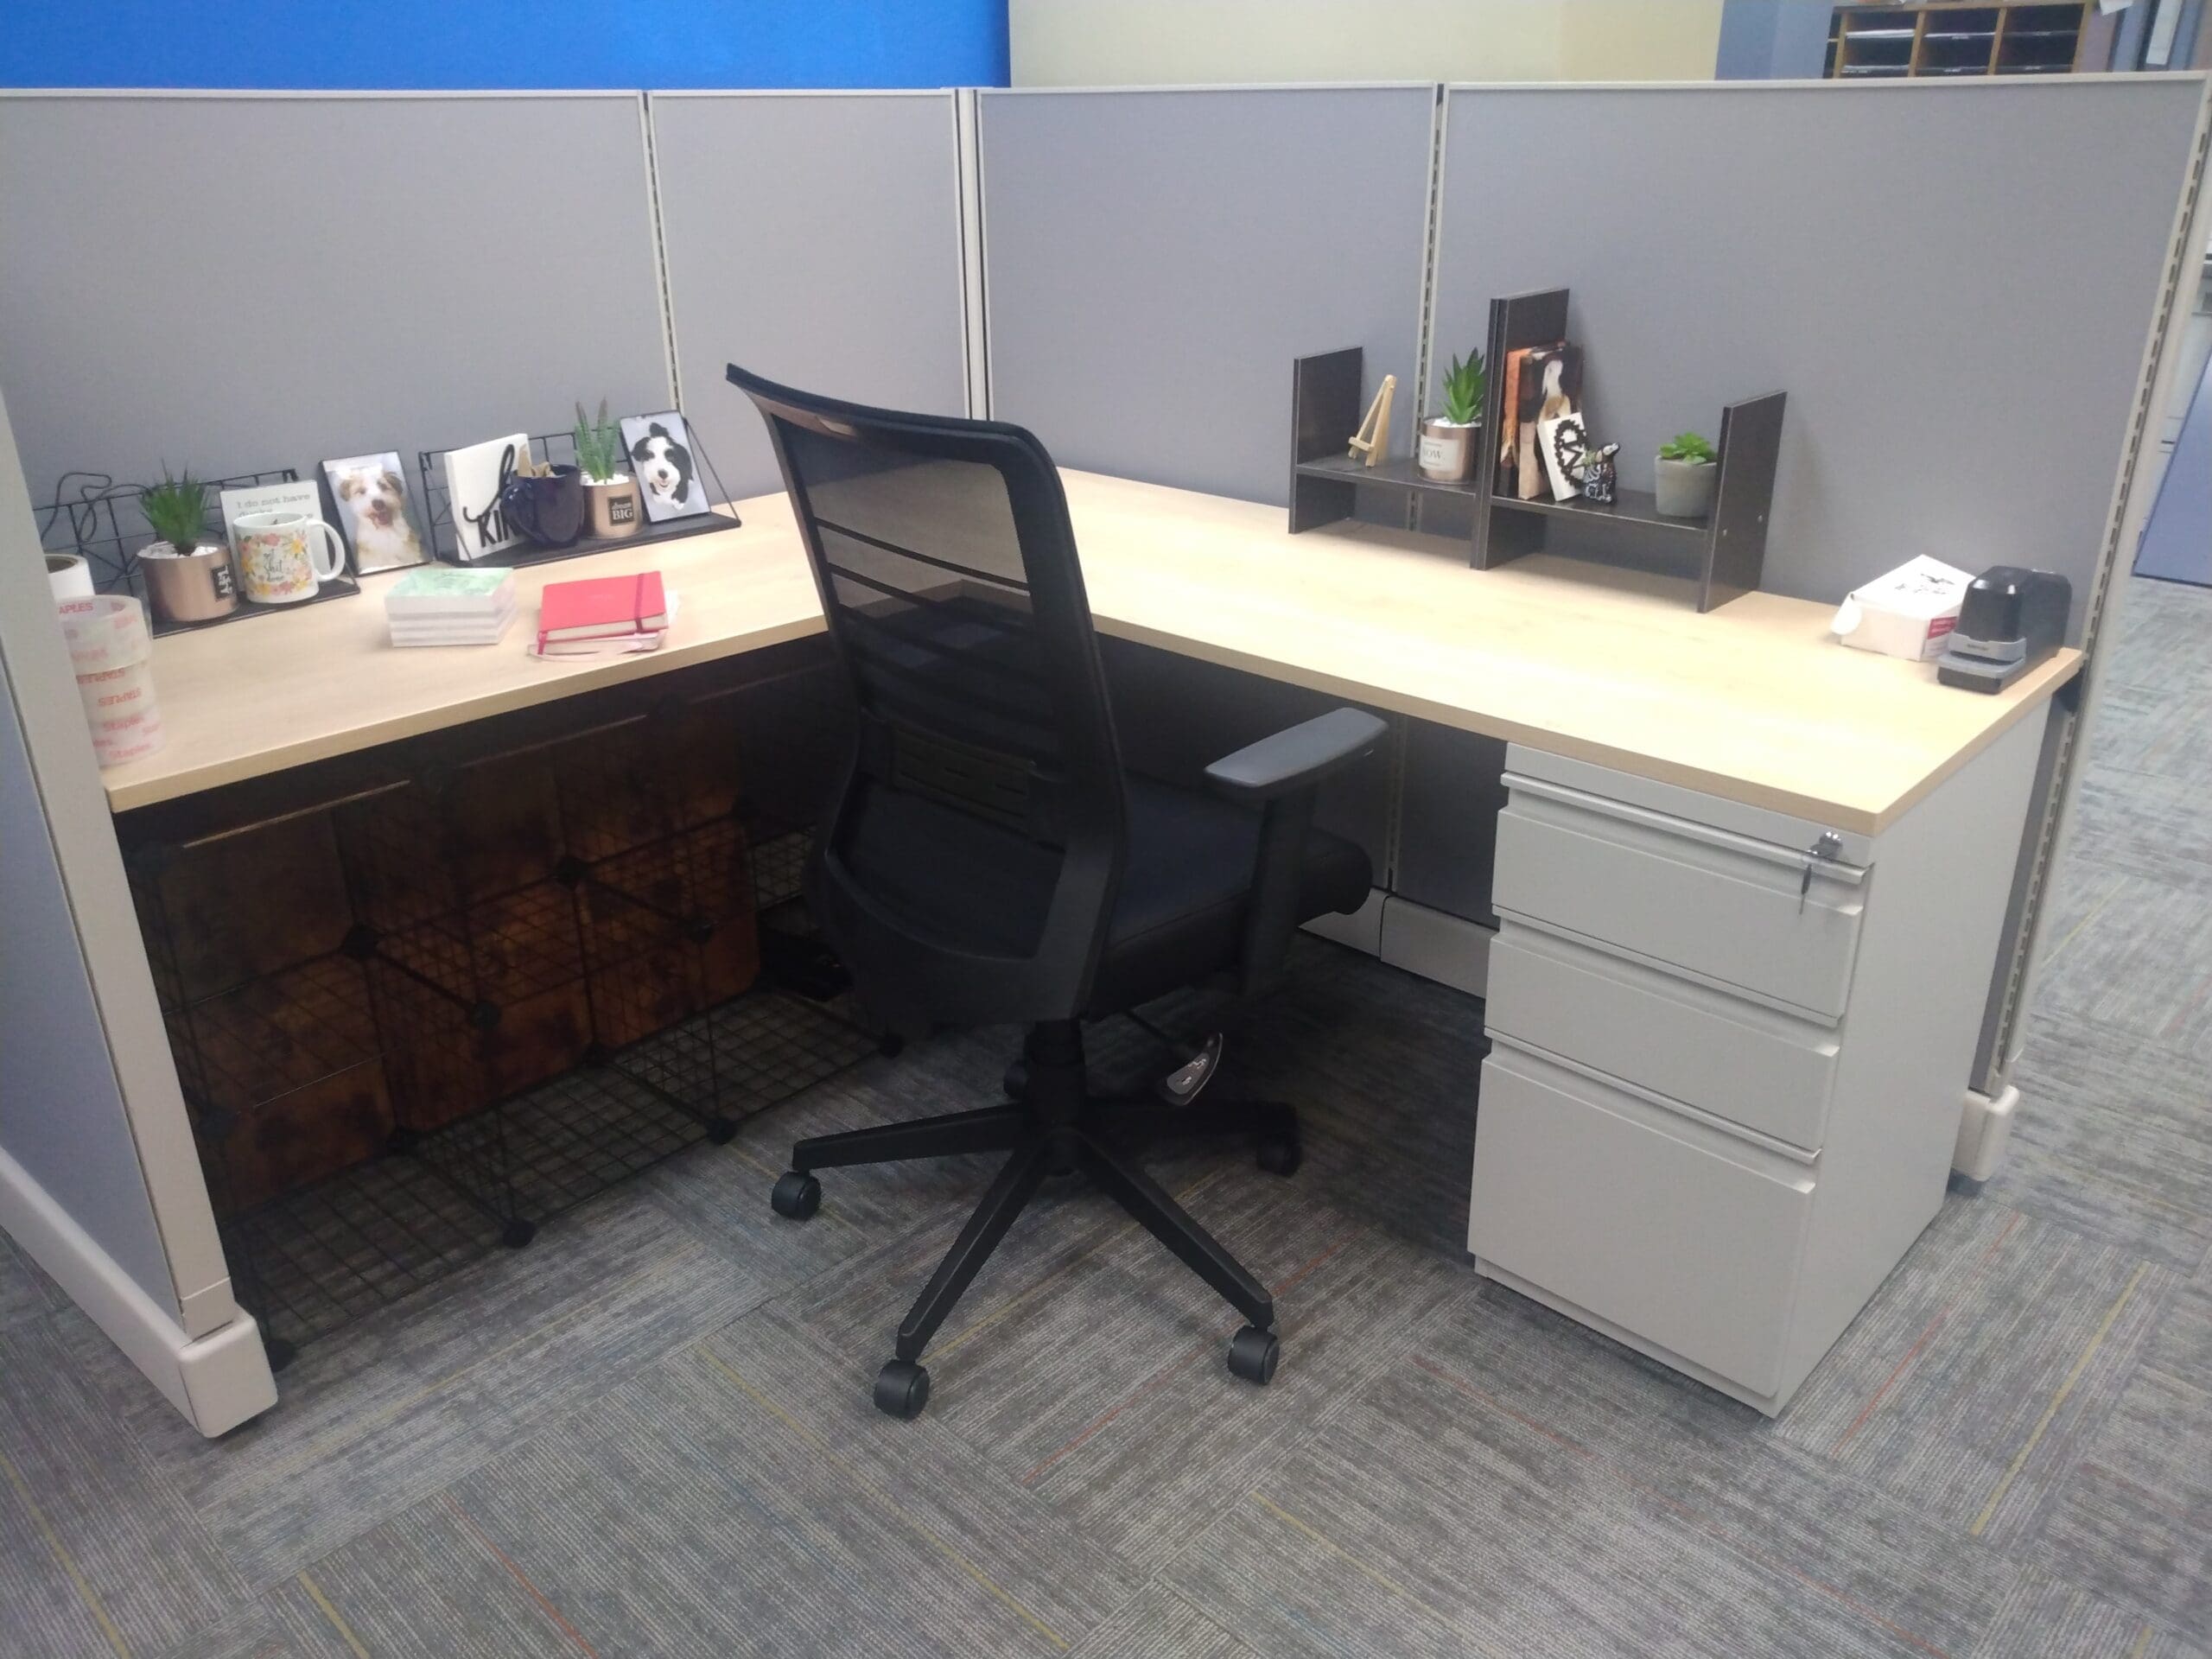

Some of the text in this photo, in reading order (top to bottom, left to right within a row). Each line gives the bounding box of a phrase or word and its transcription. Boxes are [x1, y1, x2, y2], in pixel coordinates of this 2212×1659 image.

[262, 497, 281, 505] not
[283, 493, 311, 503] have
[612, 508, 633, 520] BIG
[58, 601, 94, 614] APLES
